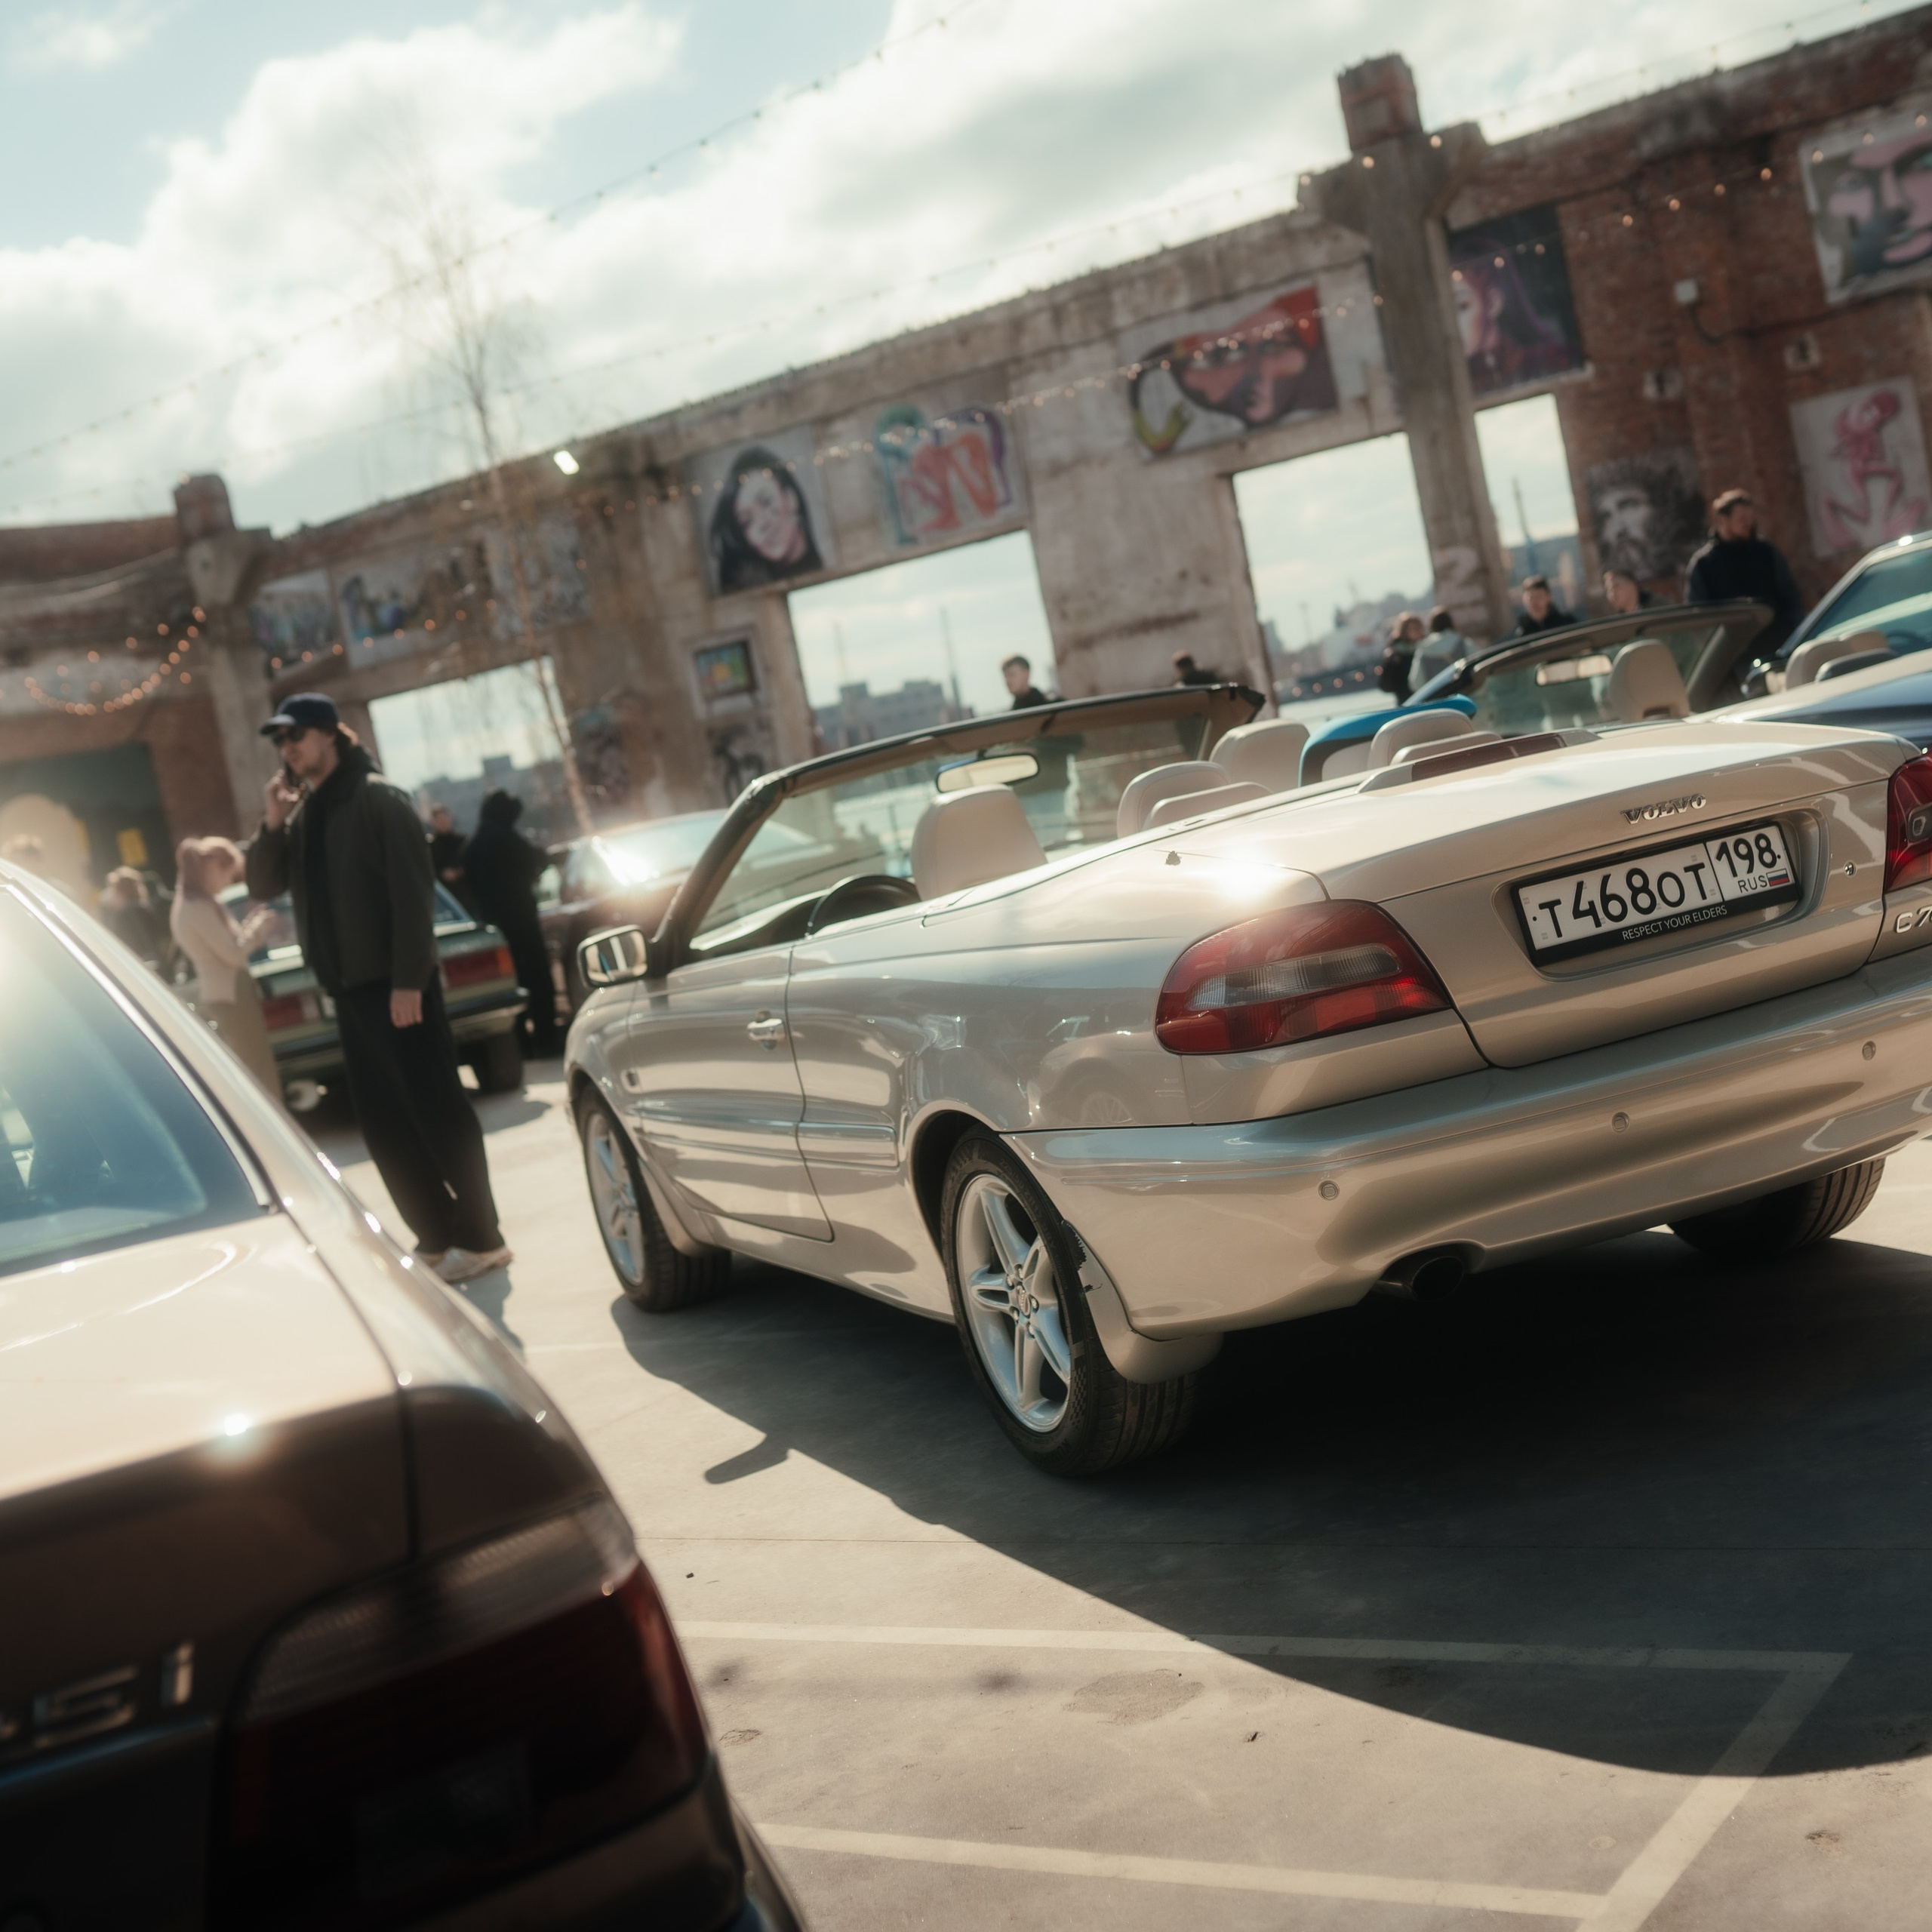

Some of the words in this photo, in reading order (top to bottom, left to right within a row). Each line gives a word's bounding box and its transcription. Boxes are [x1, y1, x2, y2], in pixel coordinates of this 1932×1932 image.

[1620, 793, 1707, 824] VOLVO
[1715, 832, 1777, 878] 198
[1737, 874, 1768, 894] RUS
[1622, 921, 1663, 940] RESPECT
[1663, 914, 1692, 929] YOUR
[1692, 905, 1728, 922] ELDERS
[1894, 905, 1932, 934] C7
